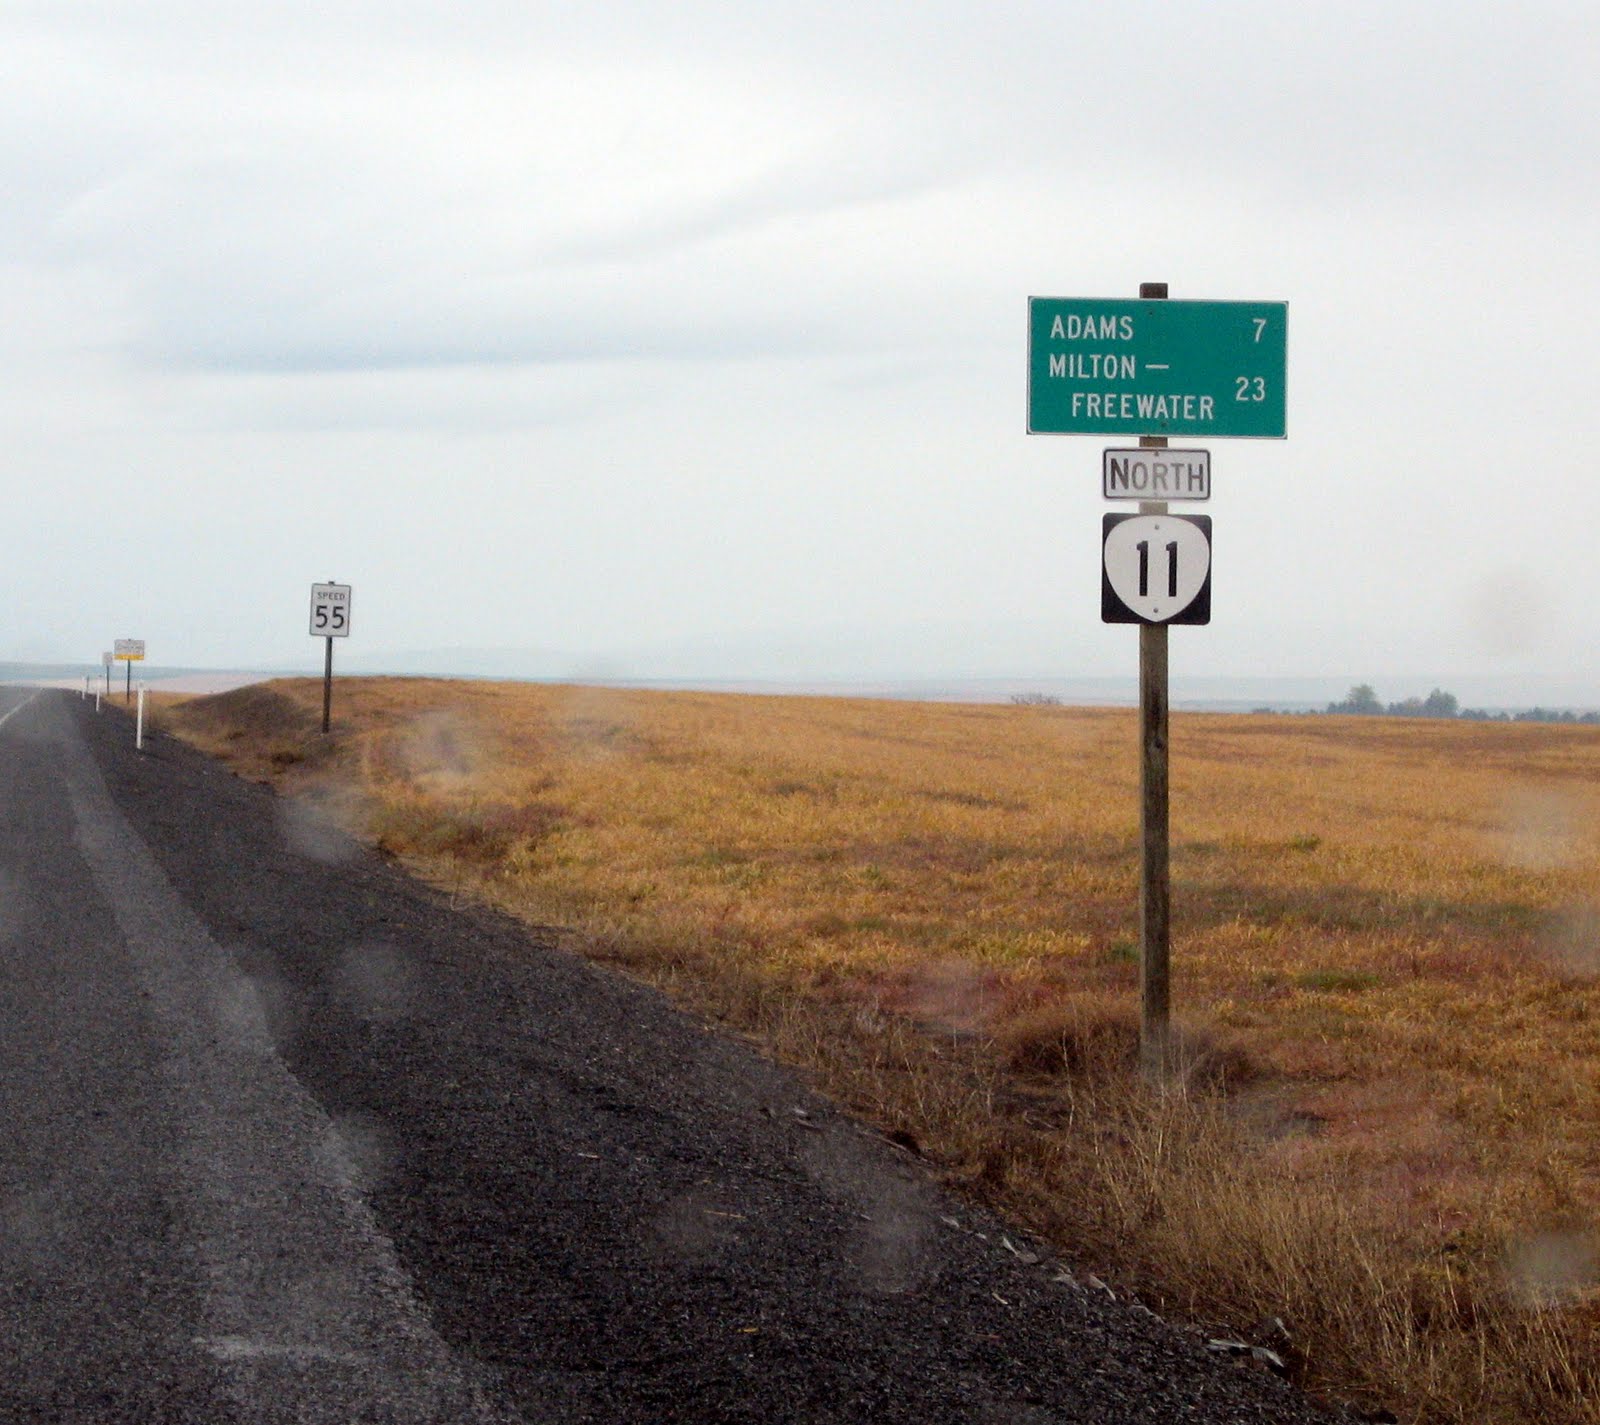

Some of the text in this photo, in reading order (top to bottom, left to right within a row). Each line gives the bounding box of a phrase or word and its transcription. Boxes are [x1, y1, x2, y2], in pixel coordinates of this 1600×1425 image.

[1049, 314, 1267, 344] ADAMS 7
[1235, 376, 1266, 402] 23
[1071, 392, 1214, 420] FREEWATER
[1110, 457, 1204, 492] NORTH
[1136, 540, 1178, 597] 11
[317, 591, 346, 601] SPEED
[315, 604, 345, 629] 55
